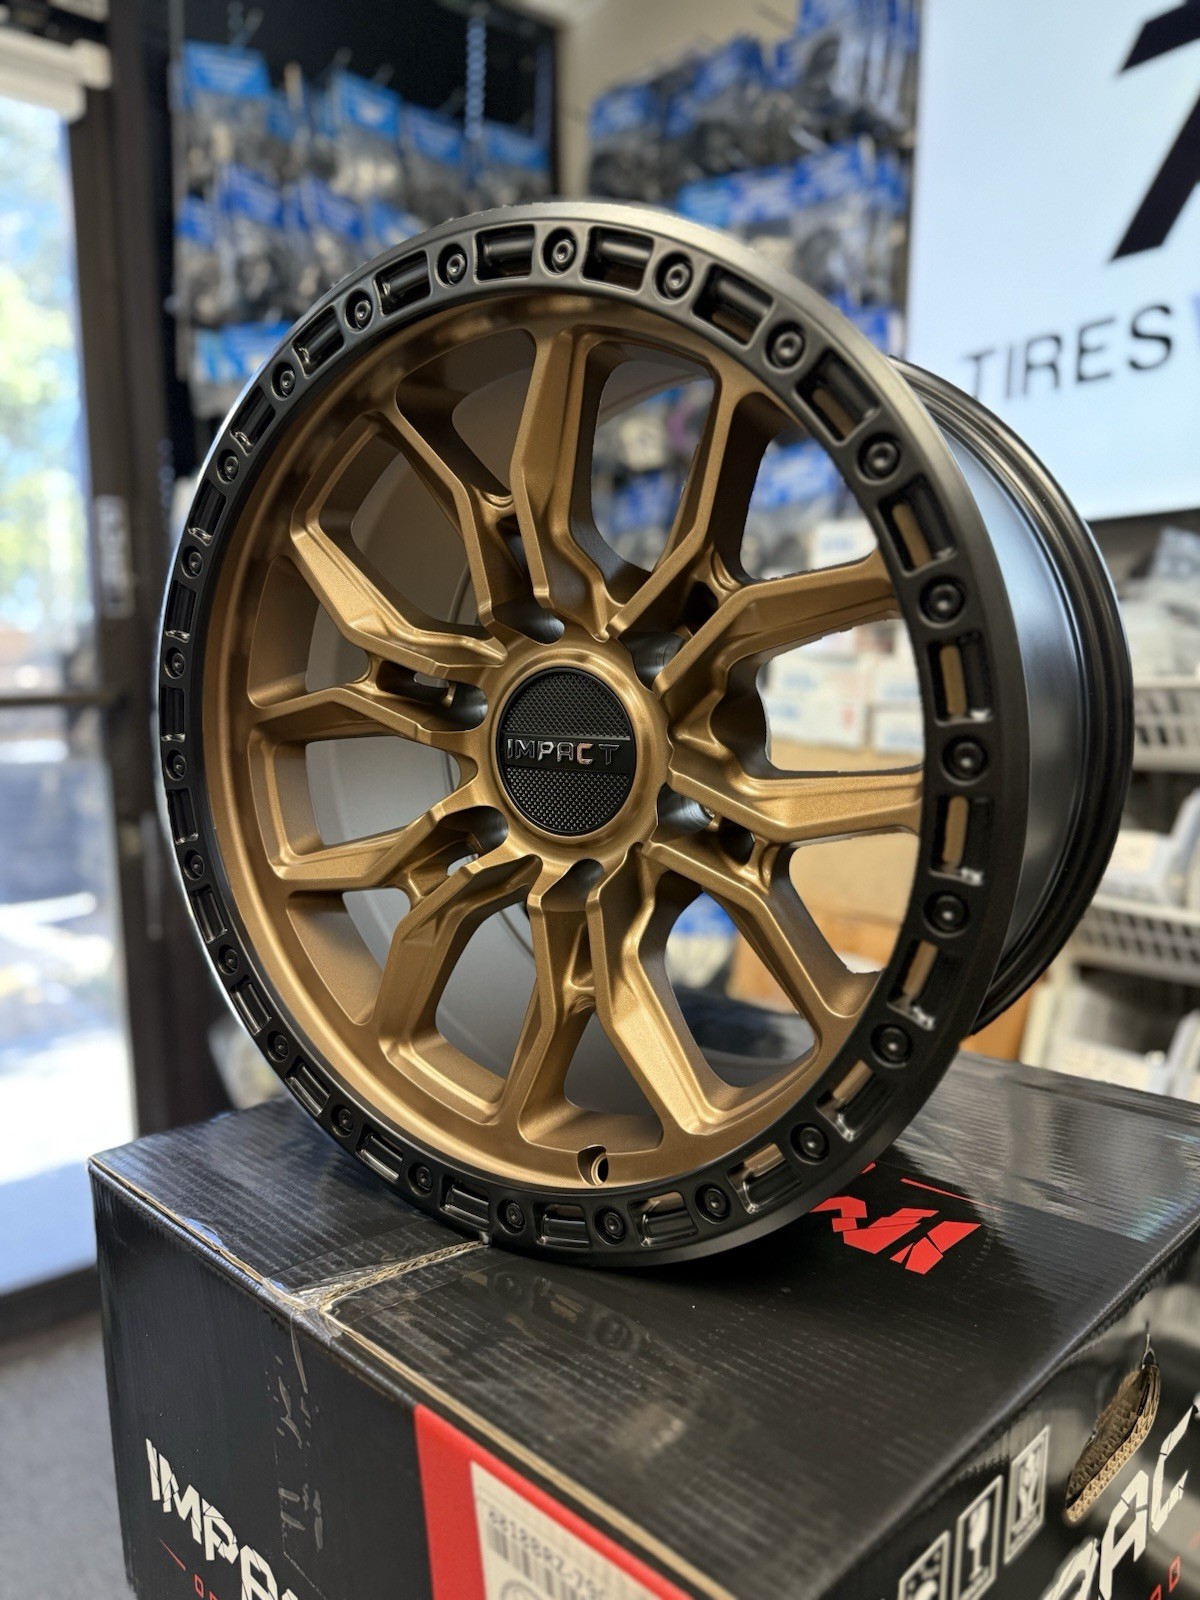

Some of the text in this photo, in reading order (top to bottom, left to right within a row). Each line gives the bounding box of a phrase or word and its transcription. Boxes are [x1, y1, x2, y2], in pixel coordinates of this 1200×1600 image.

[962, 303, 1173, 401] TIRES
[506, 738, 620, 766] IMPACT
[145, 1437, 299, 1600] IMPA
